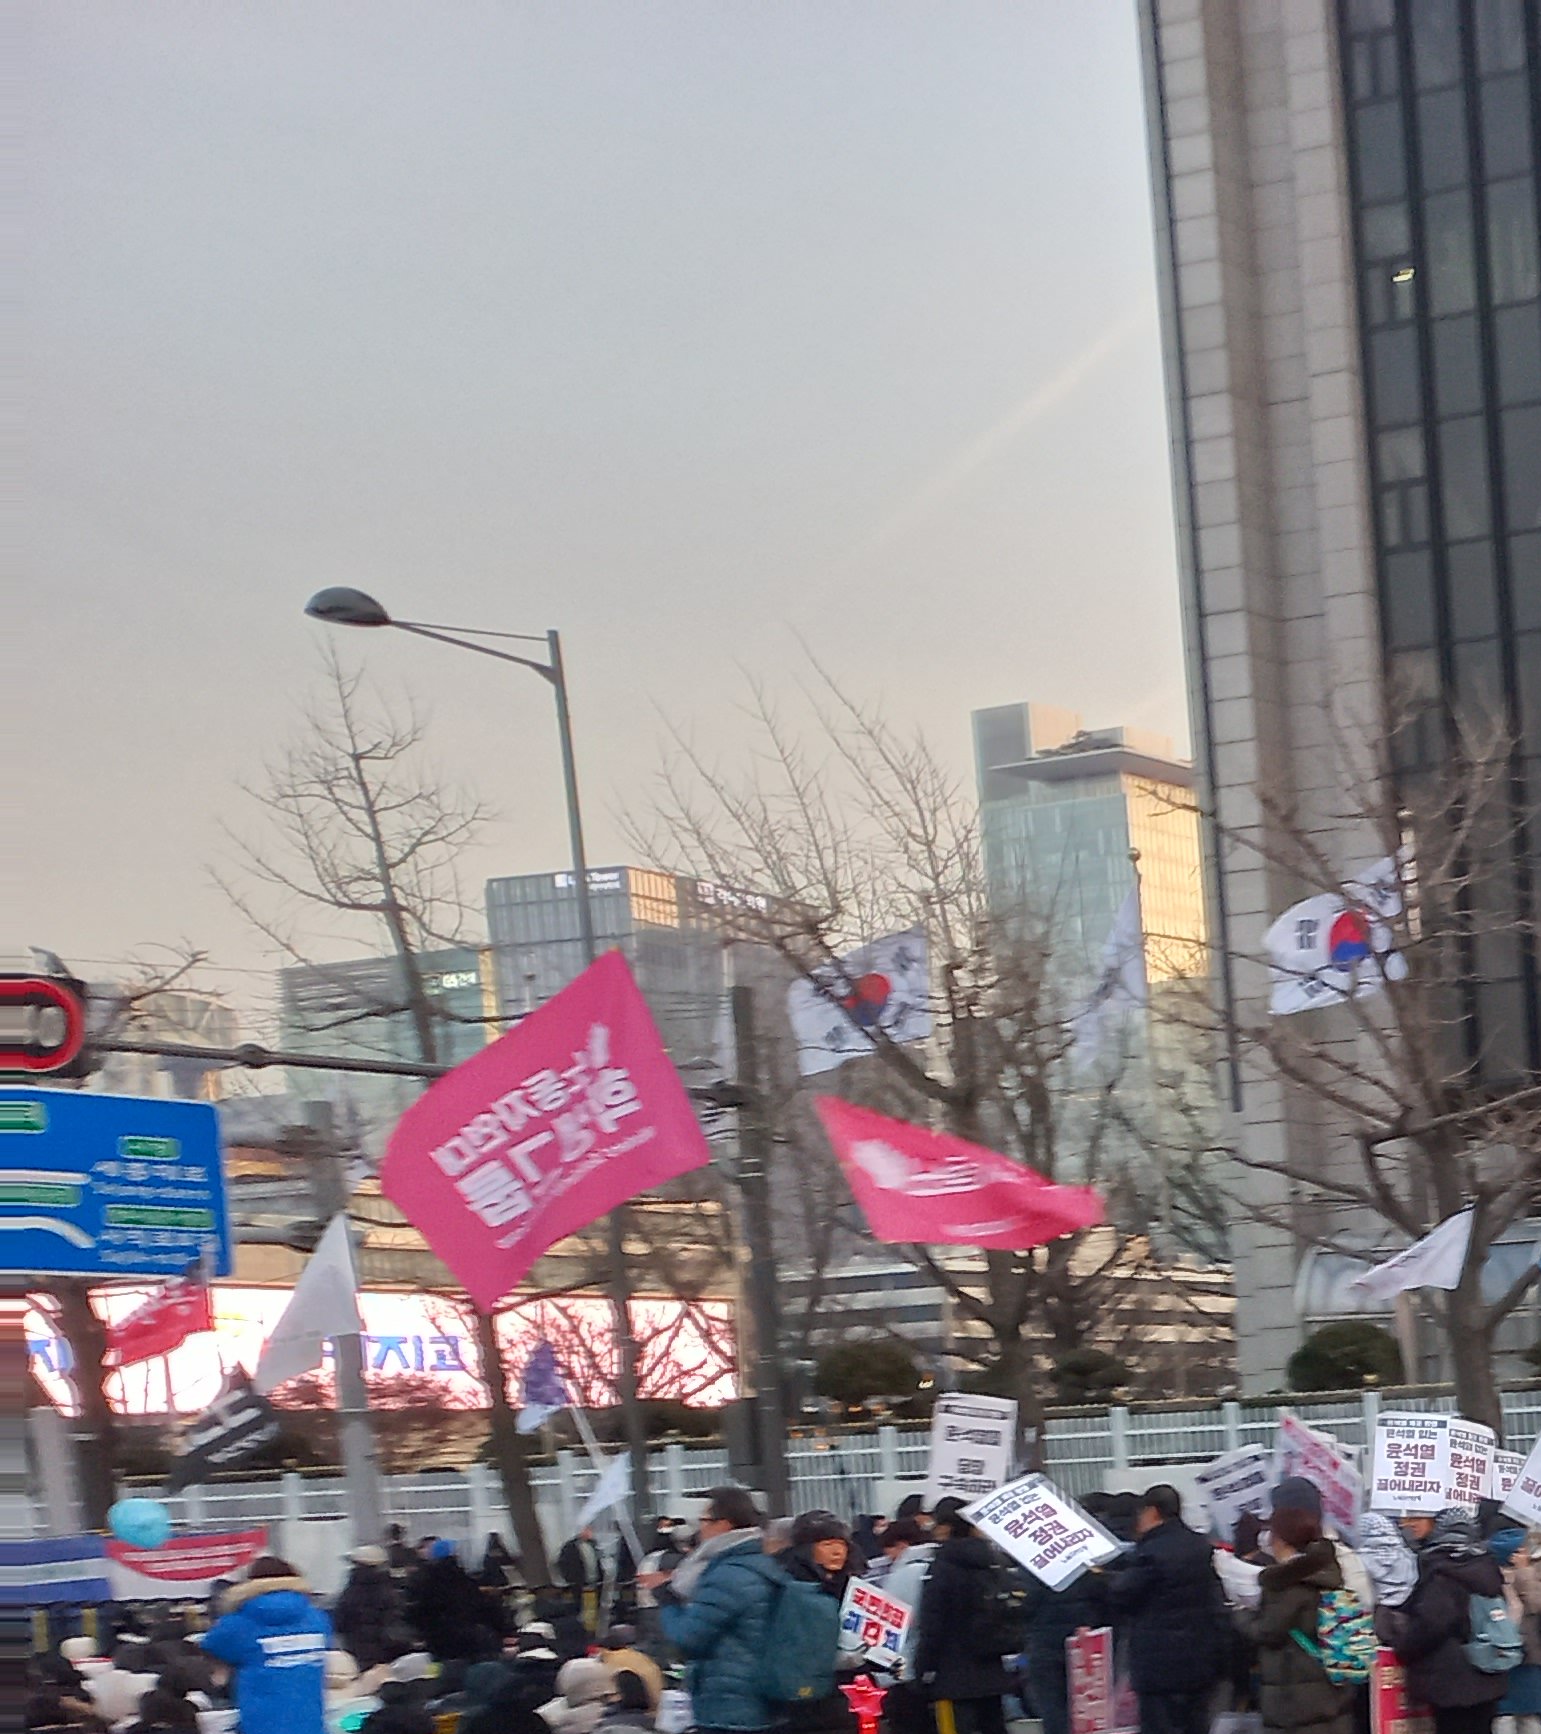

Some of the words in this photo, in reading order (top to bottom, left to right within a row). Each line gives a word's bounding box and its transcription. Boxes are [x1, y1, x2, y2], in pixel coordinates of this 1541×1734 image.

[1386, 1442, 1436, 1460] 윤석열
[1393, 1461, 1427, 1478] 정권
[1449, 1452, 1487, 1475] 윤석열
[1376, 1478, 1442, 1494] 끌어내리자
[1455, 1471, 1481, 1492] 정권
[1003, 1502, 1058, 1540] 윤석열
[1031, 1523, 1070, 1550] 정권
